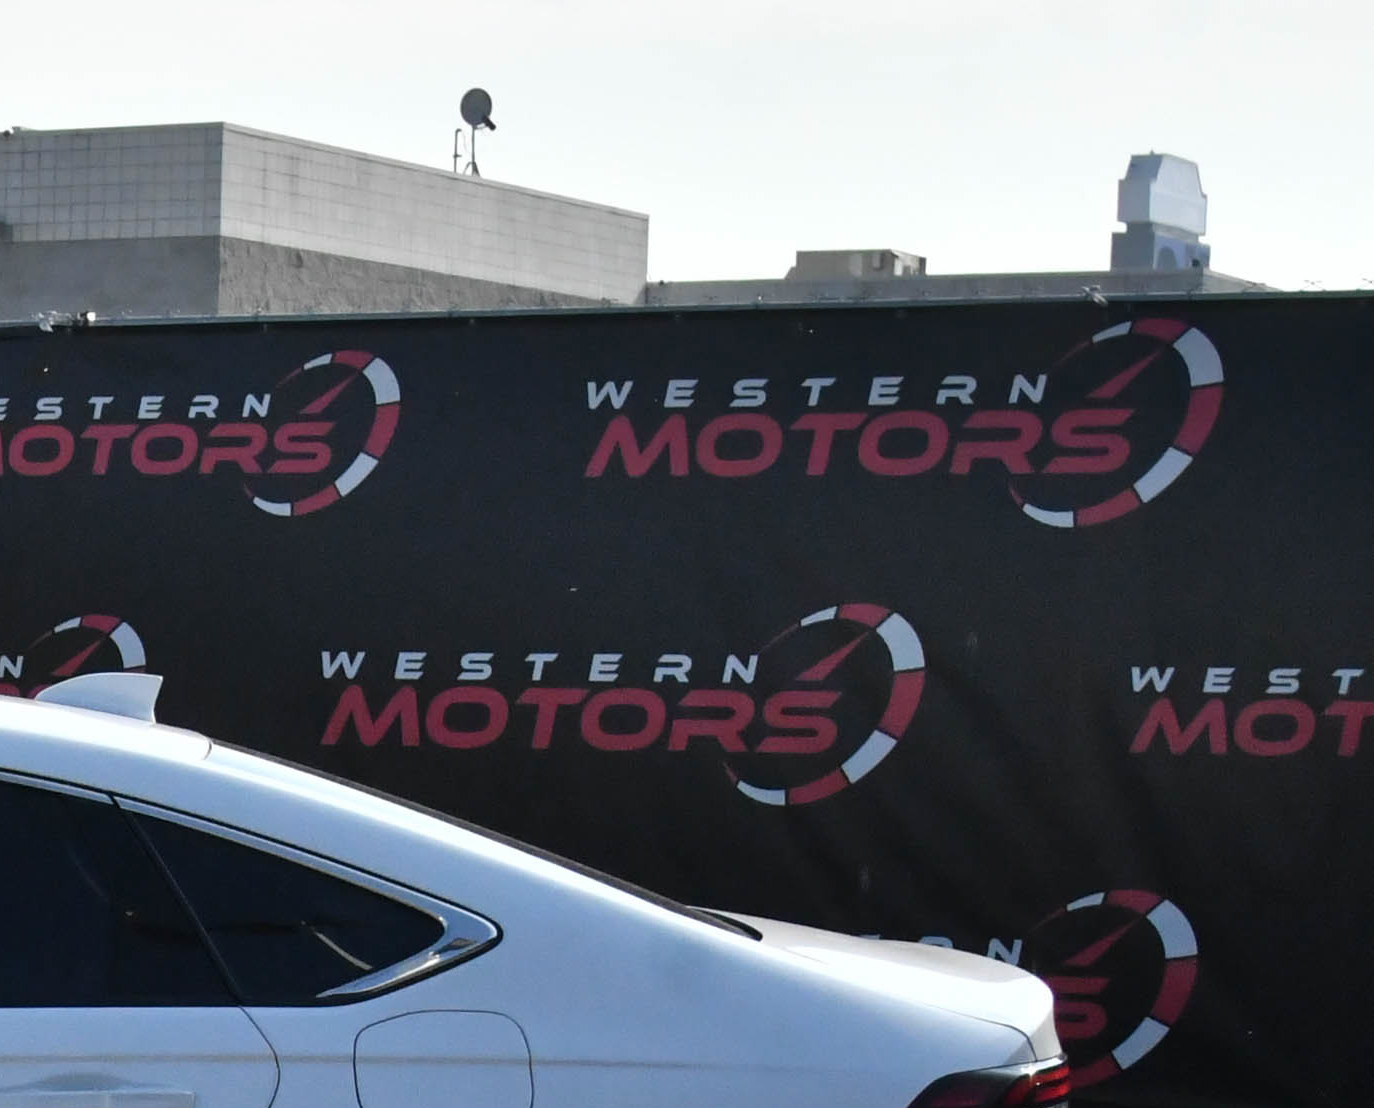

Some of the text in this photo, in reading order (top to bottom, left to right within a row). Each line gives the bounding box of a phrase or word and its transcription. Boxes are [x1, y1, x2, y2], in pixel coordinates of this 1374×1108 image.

[587, 374, 1047, 410] WESTERN
[585, 407, 1133, 478] MOTORS
[321, 650, 759, 684] WESTERN
[1131, 666, 1365, 695] WEST
[321, 684, 840, 755] MOTORS
